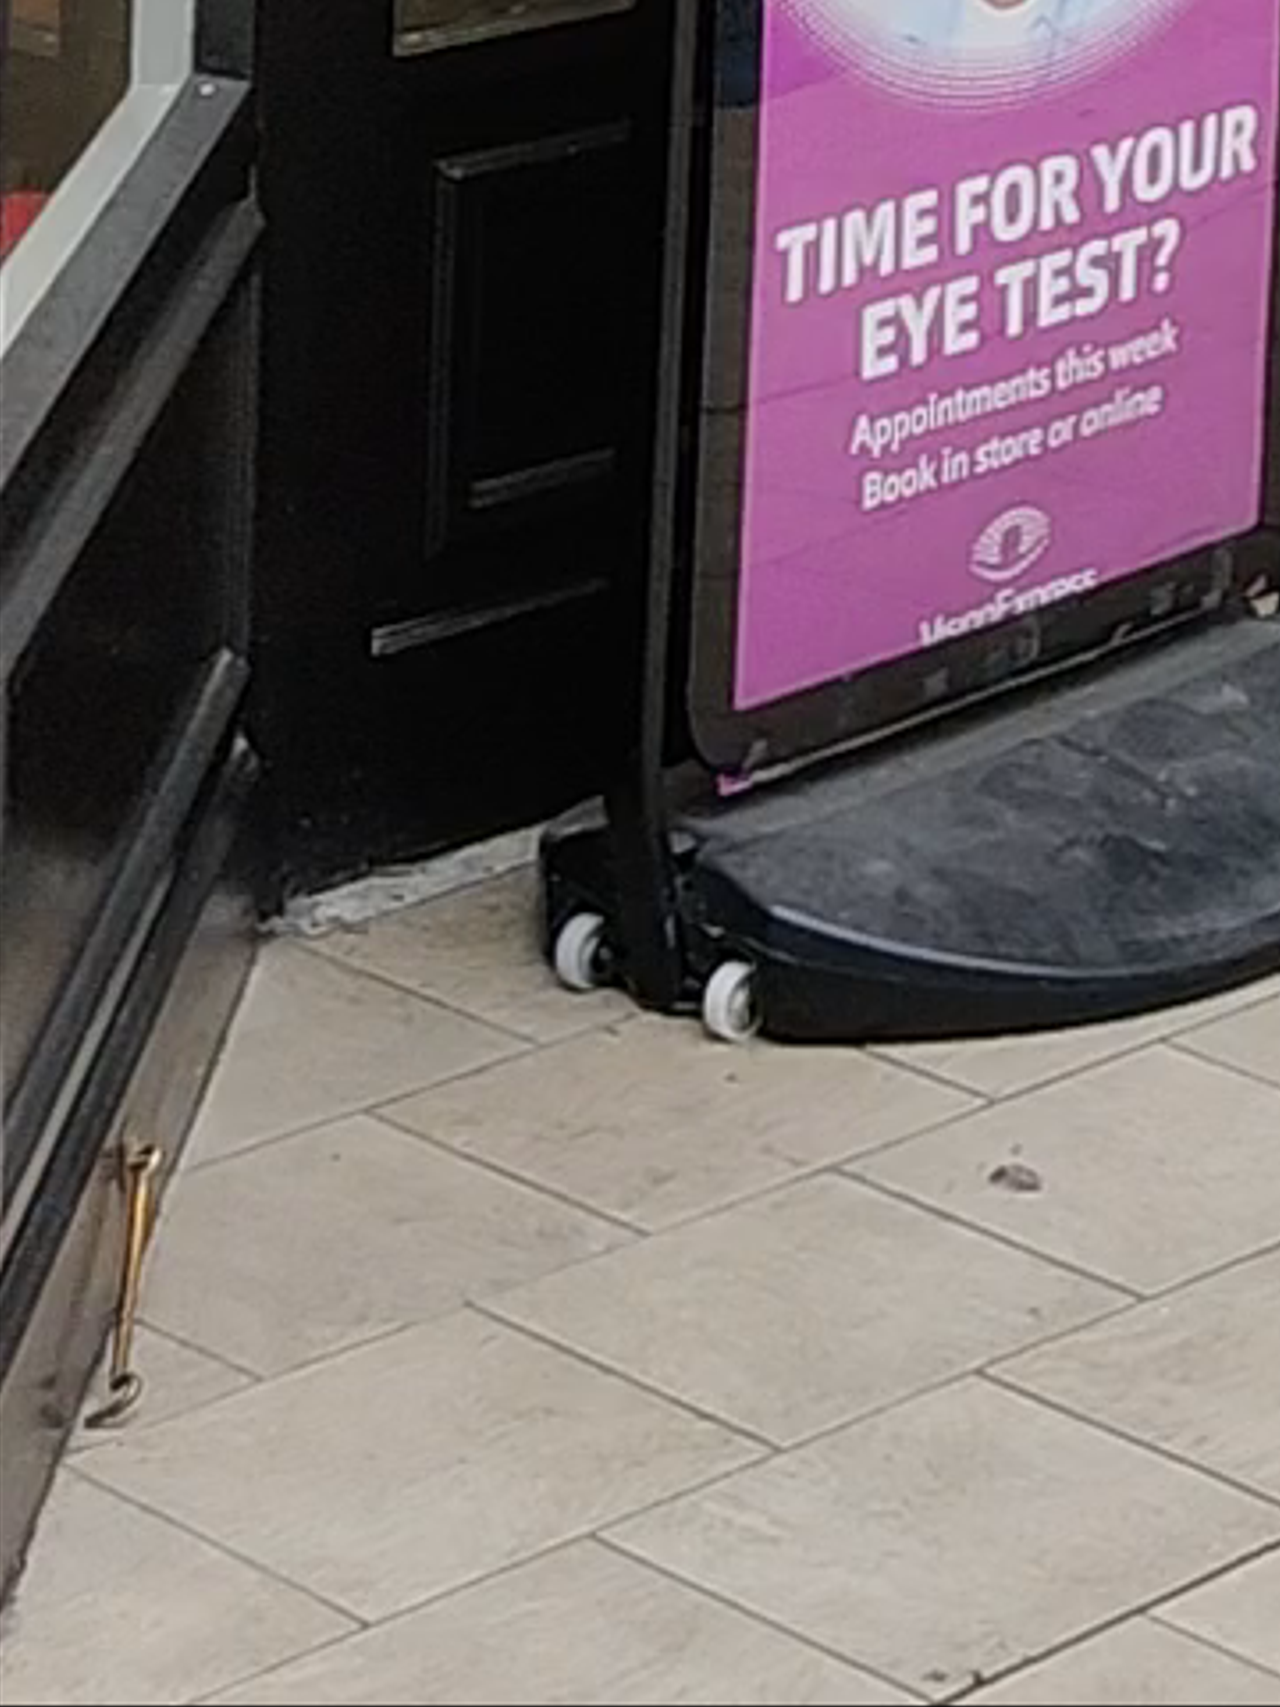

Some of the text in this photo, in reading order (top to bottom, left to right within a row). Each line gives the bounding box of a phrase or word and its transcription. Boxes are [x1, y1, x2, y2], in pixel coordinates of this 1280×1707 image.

[775, 104, 1258, 304] TIME FOR YOUR
[859, 218, 1181, 382] EYE TEST?
[849, 316, 1179, 459] Appointments this week
[860, 384, 1163, 511] Book in store or online
